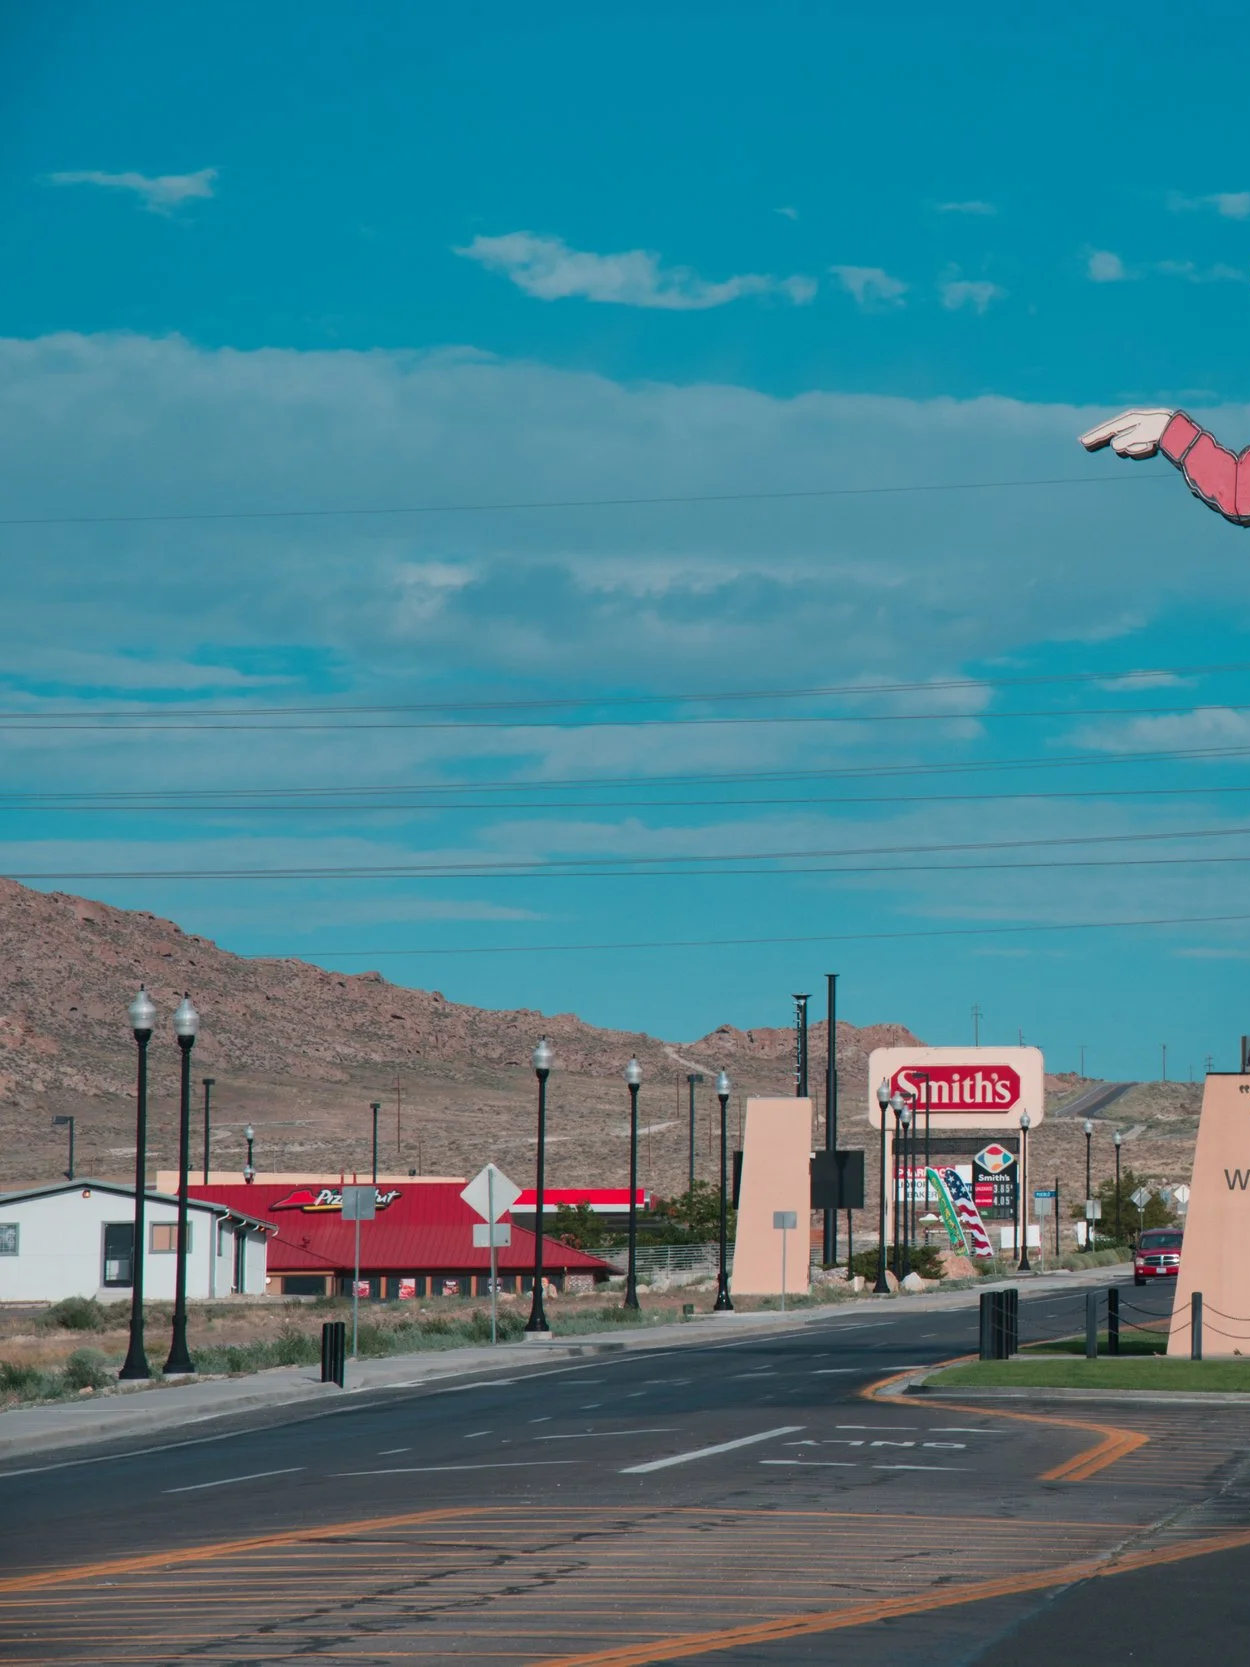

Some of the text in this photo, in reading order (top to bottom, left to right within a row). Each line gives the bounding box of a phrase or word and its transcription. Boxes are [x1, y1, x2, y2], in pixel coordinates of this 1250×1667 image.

[897, 1070, 1011, 1103] Smith's
[898, 1168, 946, 1177] PHARAC
[906, 1191, 938, 1199] BAKER
[782, 1440, 967, 1449] ONLY
